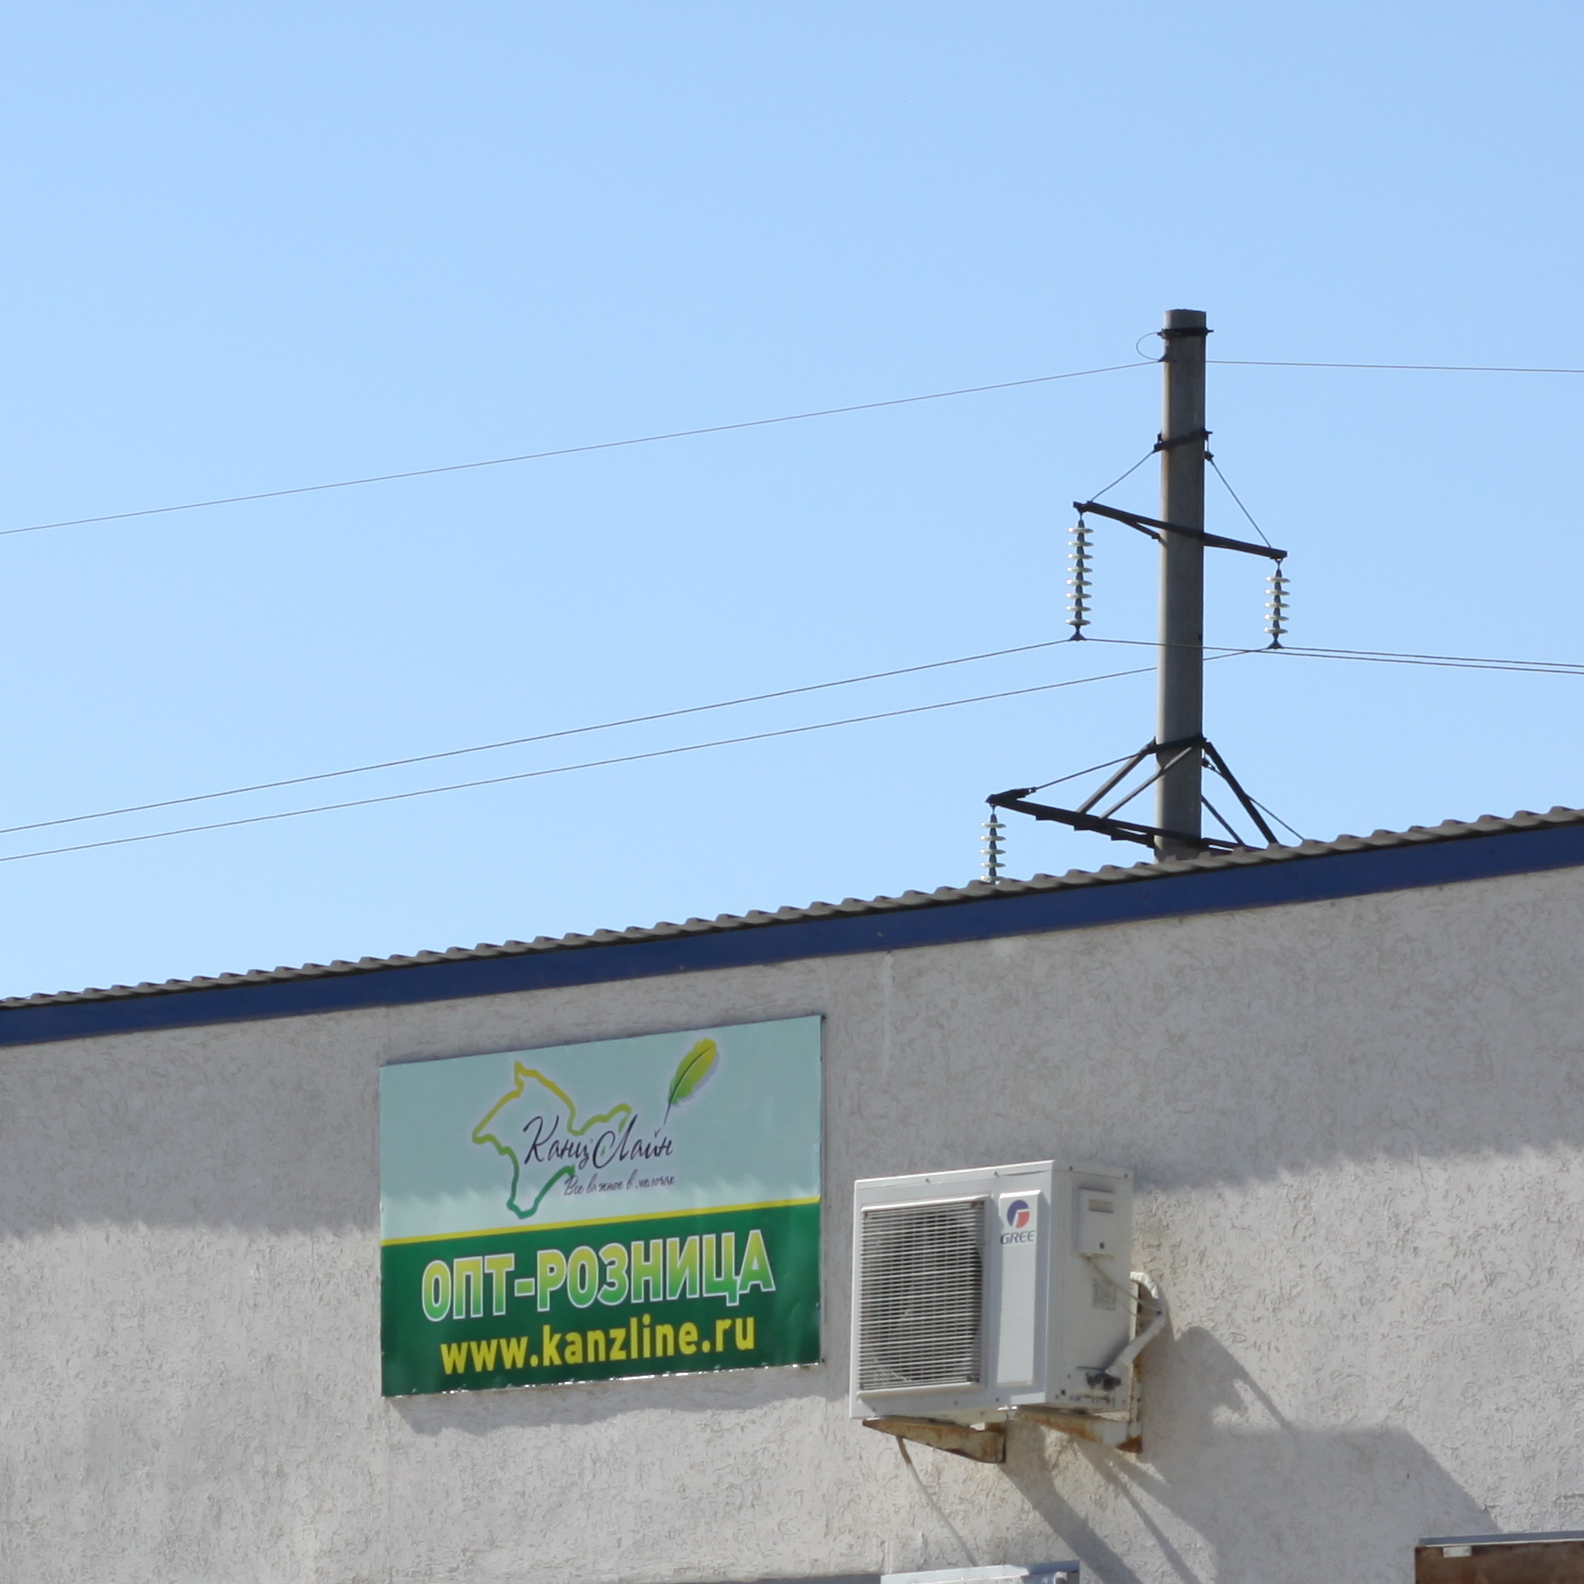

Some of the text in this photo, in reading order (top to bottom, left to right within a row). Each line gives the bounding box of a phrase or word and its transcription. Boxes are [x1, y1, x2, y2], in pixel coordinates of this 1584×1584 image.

[1000, 1230, 1036, 1245] GREE
[421, 1229, 776, 1323] ОПТ-РОЗНИЦА
[440, 1314, 755, 1375] www.kanzline.ru
